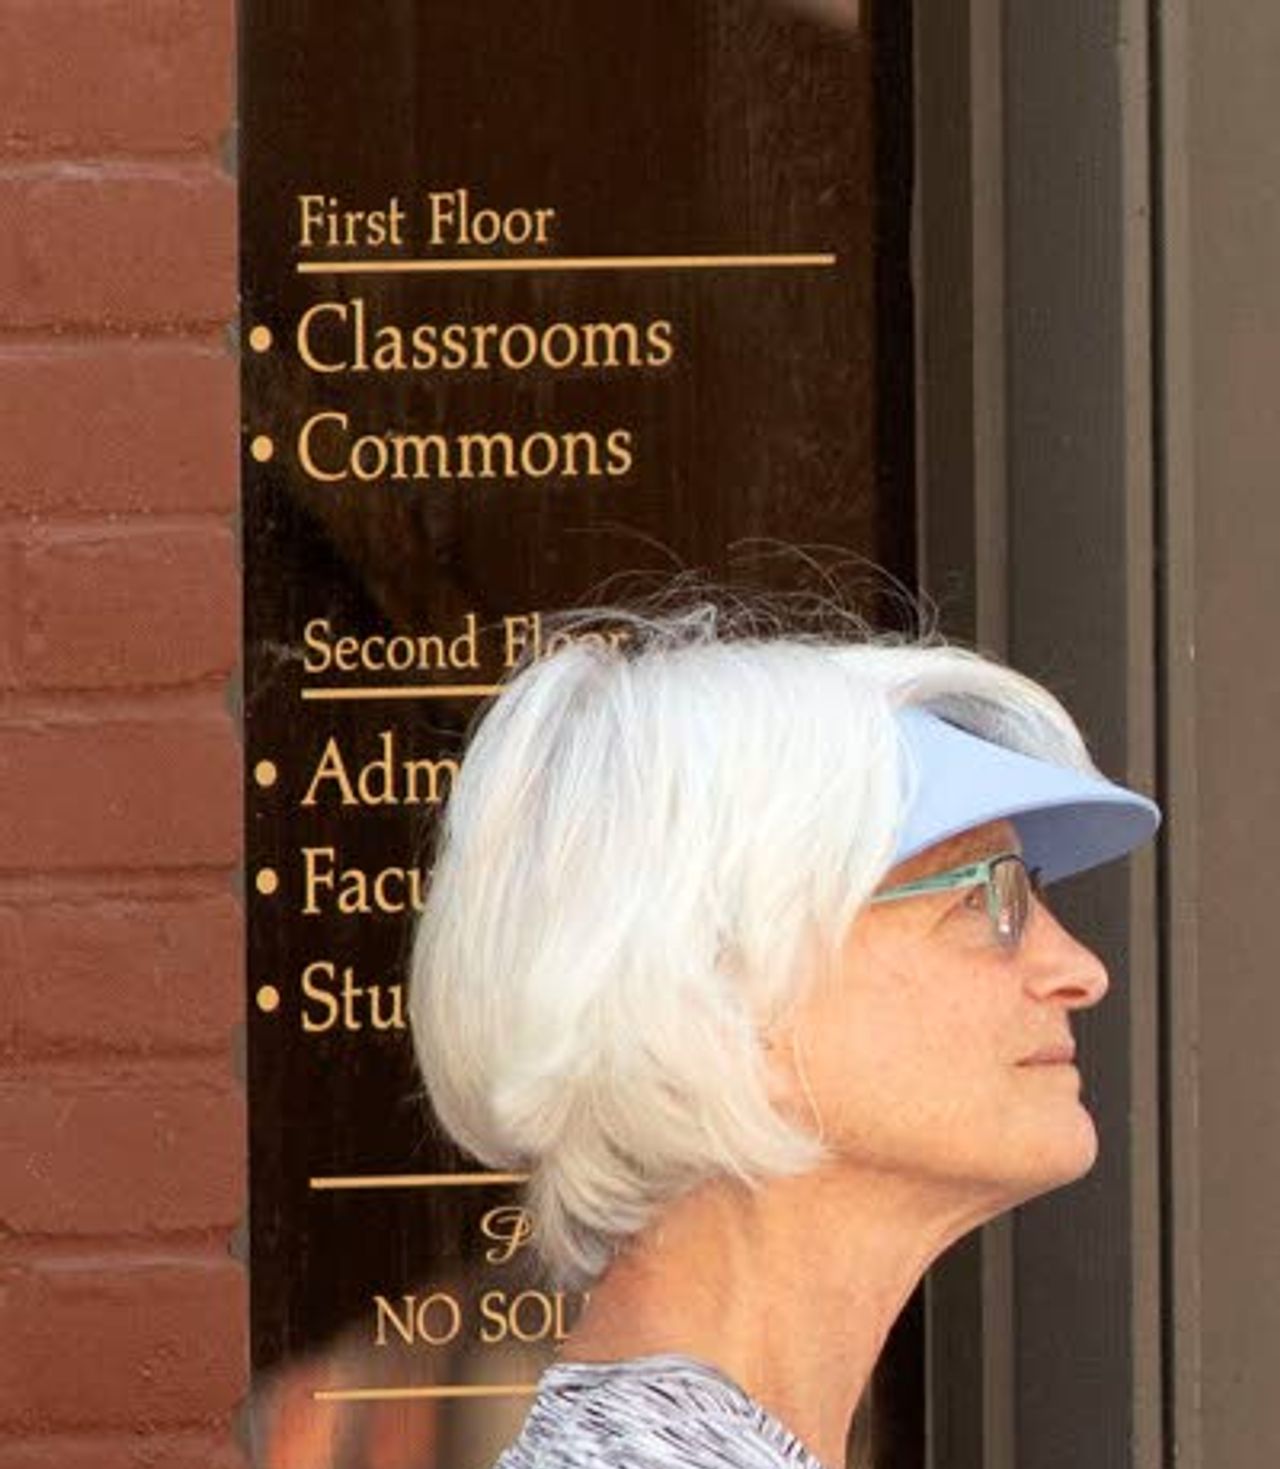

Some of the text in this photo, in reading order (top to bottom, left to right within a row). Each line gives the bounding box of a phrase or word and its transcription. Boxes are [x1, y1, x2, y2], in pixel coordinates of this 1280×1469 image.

[299, 188, 555, 247] First Floor
[297, 297, 674, 373] Classrooms
[297, 411, 633, 482] Commons
[302, 613, 480, 674] Second
[301, 730, 462, 806] Adm
[301, 847, 428, 915] Facu
[301, 961, 407, 1033] Stu
[373, 1289, 572, 1346] NO SOL
